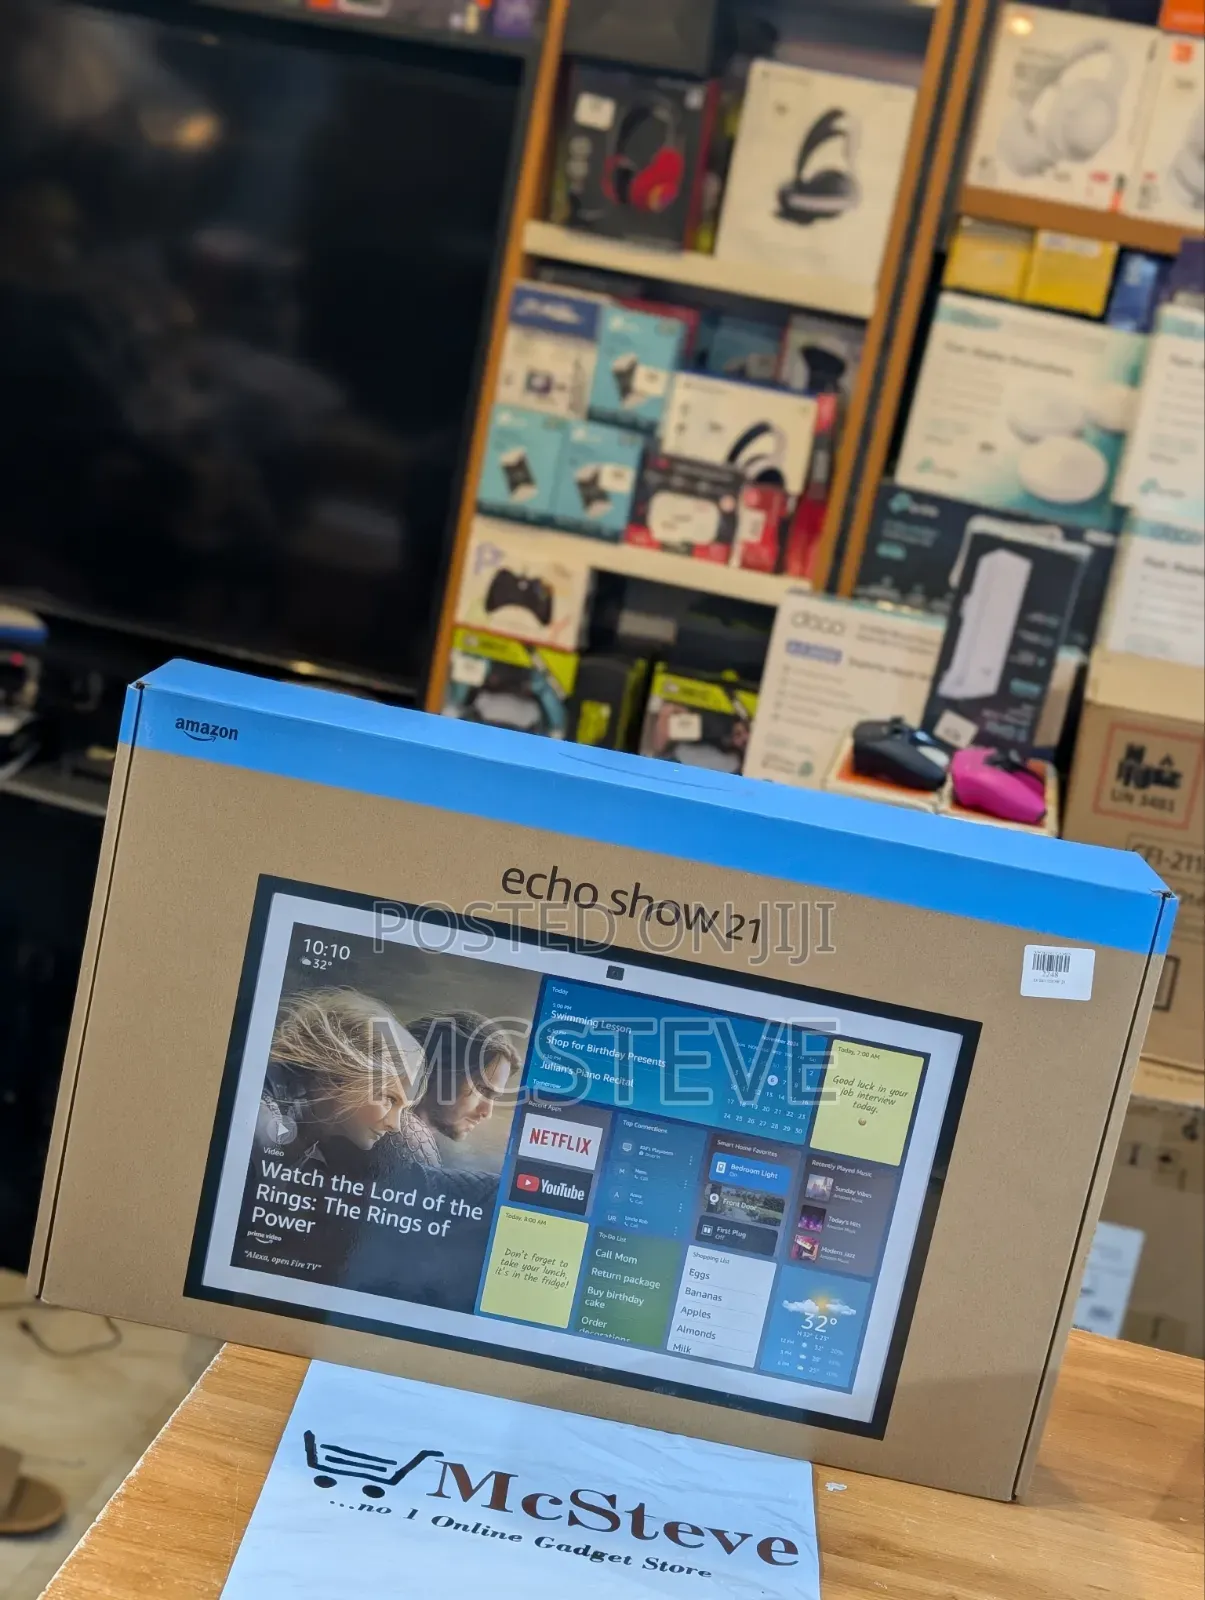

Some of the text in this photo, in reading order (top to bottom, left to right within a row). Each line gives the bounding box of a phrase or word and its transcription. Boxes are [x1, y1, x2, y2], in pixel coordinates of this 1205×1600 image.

[175, 718, 238, 742] amazon
[501, 865, 762, 944] echo show 21
[304, 939, 350, 960] 10:10
[313, 958, 332, 970] 32°
[552, 986, 569, 996] Today
[551, 1010, 632, 1034] Swimming Lesson
[546, 1035, 666, 1068] Shop for Birthday Presents
[838, 1046, 856, 1056] Today,
[870, 1053, 881, 1061] AM
[540, 1061, 634, 1088] Julian's Piano Recital
[832, 1075, 909, 1099] Good luck in your
[839, 1087, 896, 1107] job interview
[852, 1100, 879, 1116] today.
[623, 1119, 668, 1134] Top Connections
[529, 1127, 592, 1156] NETFLIX
[717, 1139, 778, 1158] Smart Home Favorites
[263, 1147, 285, 1157] Video
[731, 1163, 778, 1180] Bedroom Light
[811, 1159, 873, 1178] Recently Played Music
[261, 1159, 483, 1221] Watch the Lord of the
[541, 1178, 585, 1202] YouTube
[835, 1186, 856, 1196] Sunday
[255, 1184, 452, 1238] Rings: The Rings of
[722, 1198, 758, 1211] Front Door
[251, 1206, 316, 1234] Power
[829, 1216, 849, 1226] Today's
[247, 1230, 282, 1242] prime video
[598, 1231, 627, 1244] To-Do List
[716, 1226, 747, 1240] First Plug
[505, 1248, 569, 1269] Don't forget to
[595, 1249, 638, 1265] Call Mom
[692, 1251, 730, 1265] Shopping List
[821, 1246, 843, 1256] Modern
[271, 1256, 290, 1266] open
[290, 1260, 305, 1269] Fire
[500, 1258, 568, 1280] take your lunch,
[495, 1267, 570, 1290] it's in the fridge!
[591, 1267, 661, 1290] Return package
[689, 1268, 710, 1281] Eggs
[587, 1286, 645, 1306] Buy birthday
[685, 1286, 723, 1302] Bananas
[584, 1298, 606, 1309] cake
[680, 1306, 712, 1320] Apples
[581, 1316, 608, 1329] Order
[801, 1312, 838, 1333] 32°
[676, 1324, 717, 1341] Almonds
[673, 1343, 692, 1354] Milk
[426, 1458, 800, 1568] McSteve
[330, 1500, 714, 1580] ...no 1 Online Gadget Store
